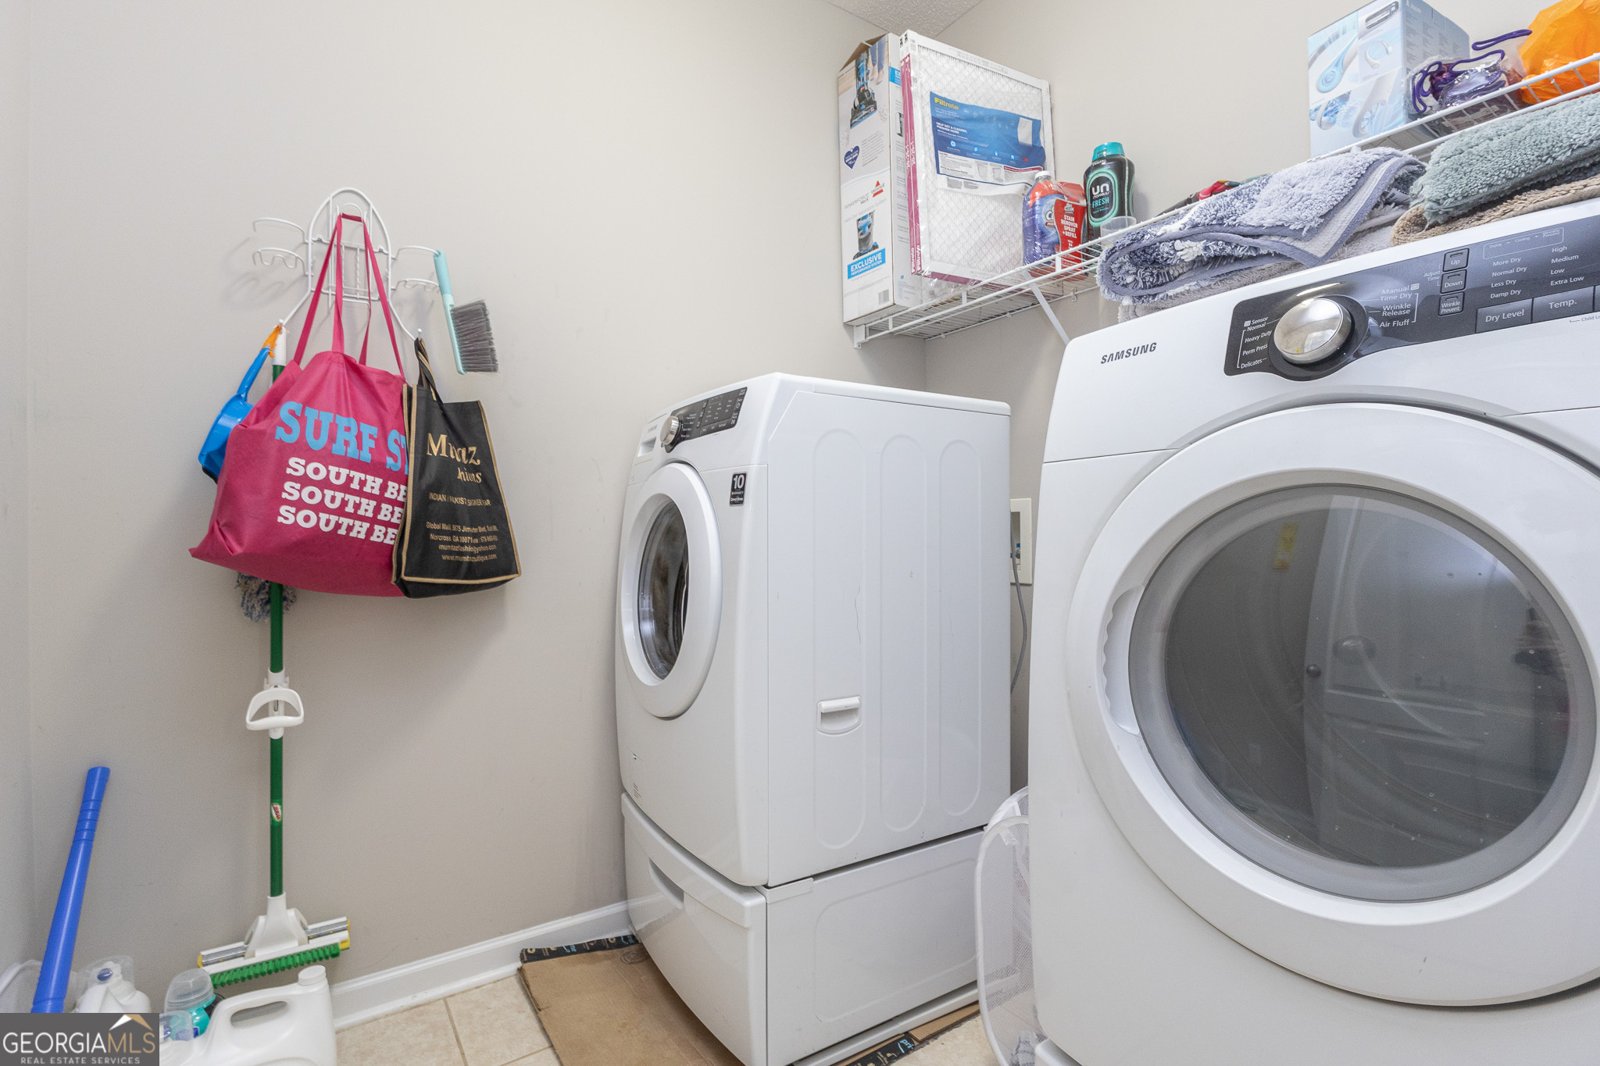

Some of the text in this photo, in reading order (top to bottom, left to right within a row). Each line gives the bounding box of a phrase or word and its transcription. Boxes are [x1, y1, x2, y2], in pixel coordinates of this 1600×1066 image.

[1552, 245, 1568, 253] High
[851, 252, 882, 271] EXCLUSIVE
[1450, 258, 1461, 266] Up
[1493, 256, 1522, 267] More Dry
[1551, 254, 1579, 264] Medium
[1492, 266, 1528, 277] Normal Dry
[1551, 267, 1565, 275] Low
[1444, 279, 1463, 288] Down
[1491, 278, 1517, 288] Less Dry
[1551, 275, 1585, 287] Extra Low
[1382, 285, 1410, 294] Manual
[1490, 288, 1522, 300] Damp Dry
[1382, 303, 1411, 311] Wrinkle
[1549, 299, 1577, 310] Temp.
[1382, 309, 1411, 317] Release
[1485, 309, 1525, 324] Dry Level
[1392, 319, 1410, 327] Fluff
[1100, 342, 1157, 364] SAMSUNG
[1241, 359, 1262, 369] Delicates
[275, 401, 378, 463] SURF
[286, 457, 383, 495] SOUTH
[733, 474, 744, 489] 10
[281, 481, 377, 518] SOUTH
[277, 505, 399, 545] SOUTH BE
